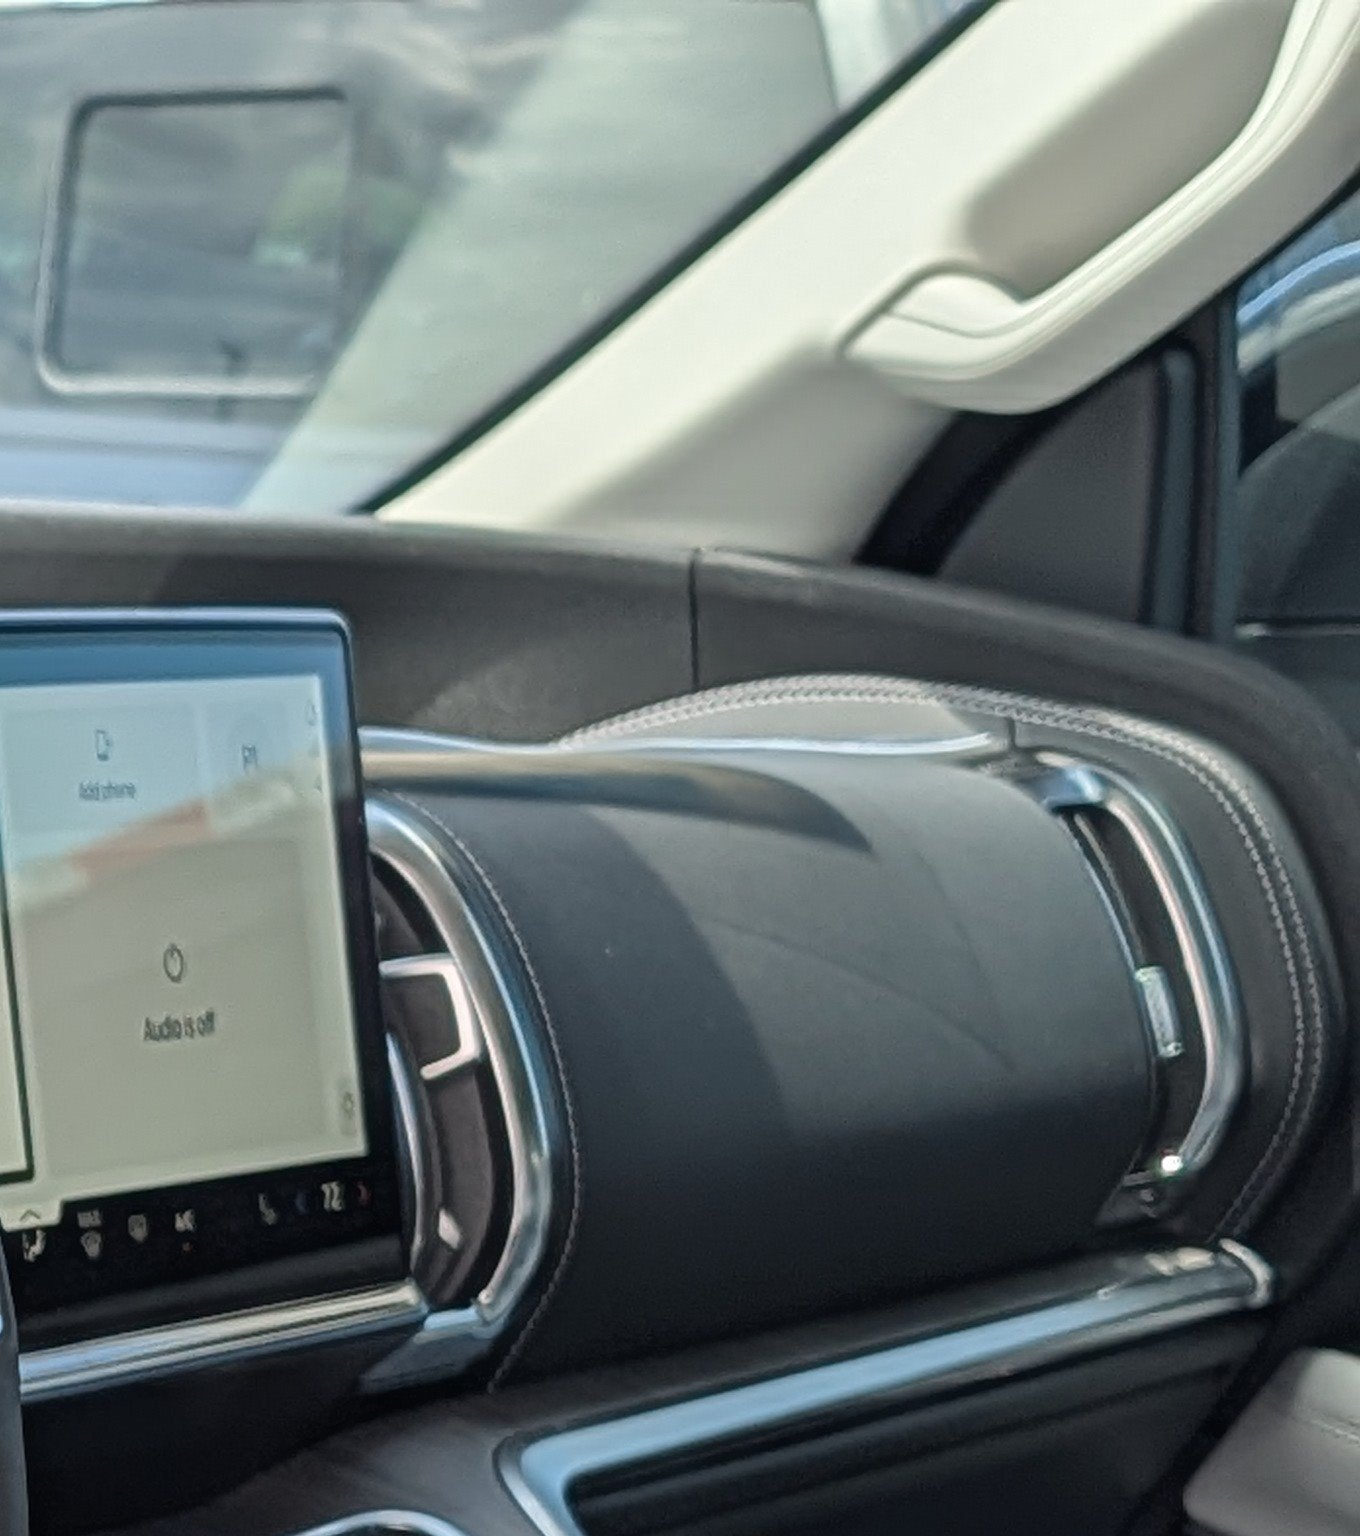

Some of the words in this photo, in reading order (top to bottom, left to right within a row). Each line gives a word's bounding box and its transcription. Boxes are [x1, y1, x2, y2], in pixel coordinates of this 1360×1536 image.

[143, 1016, 181, 1042] Audio
[183, 1016, 195, 1040] is
[196, 1008, 216, 1037] off
